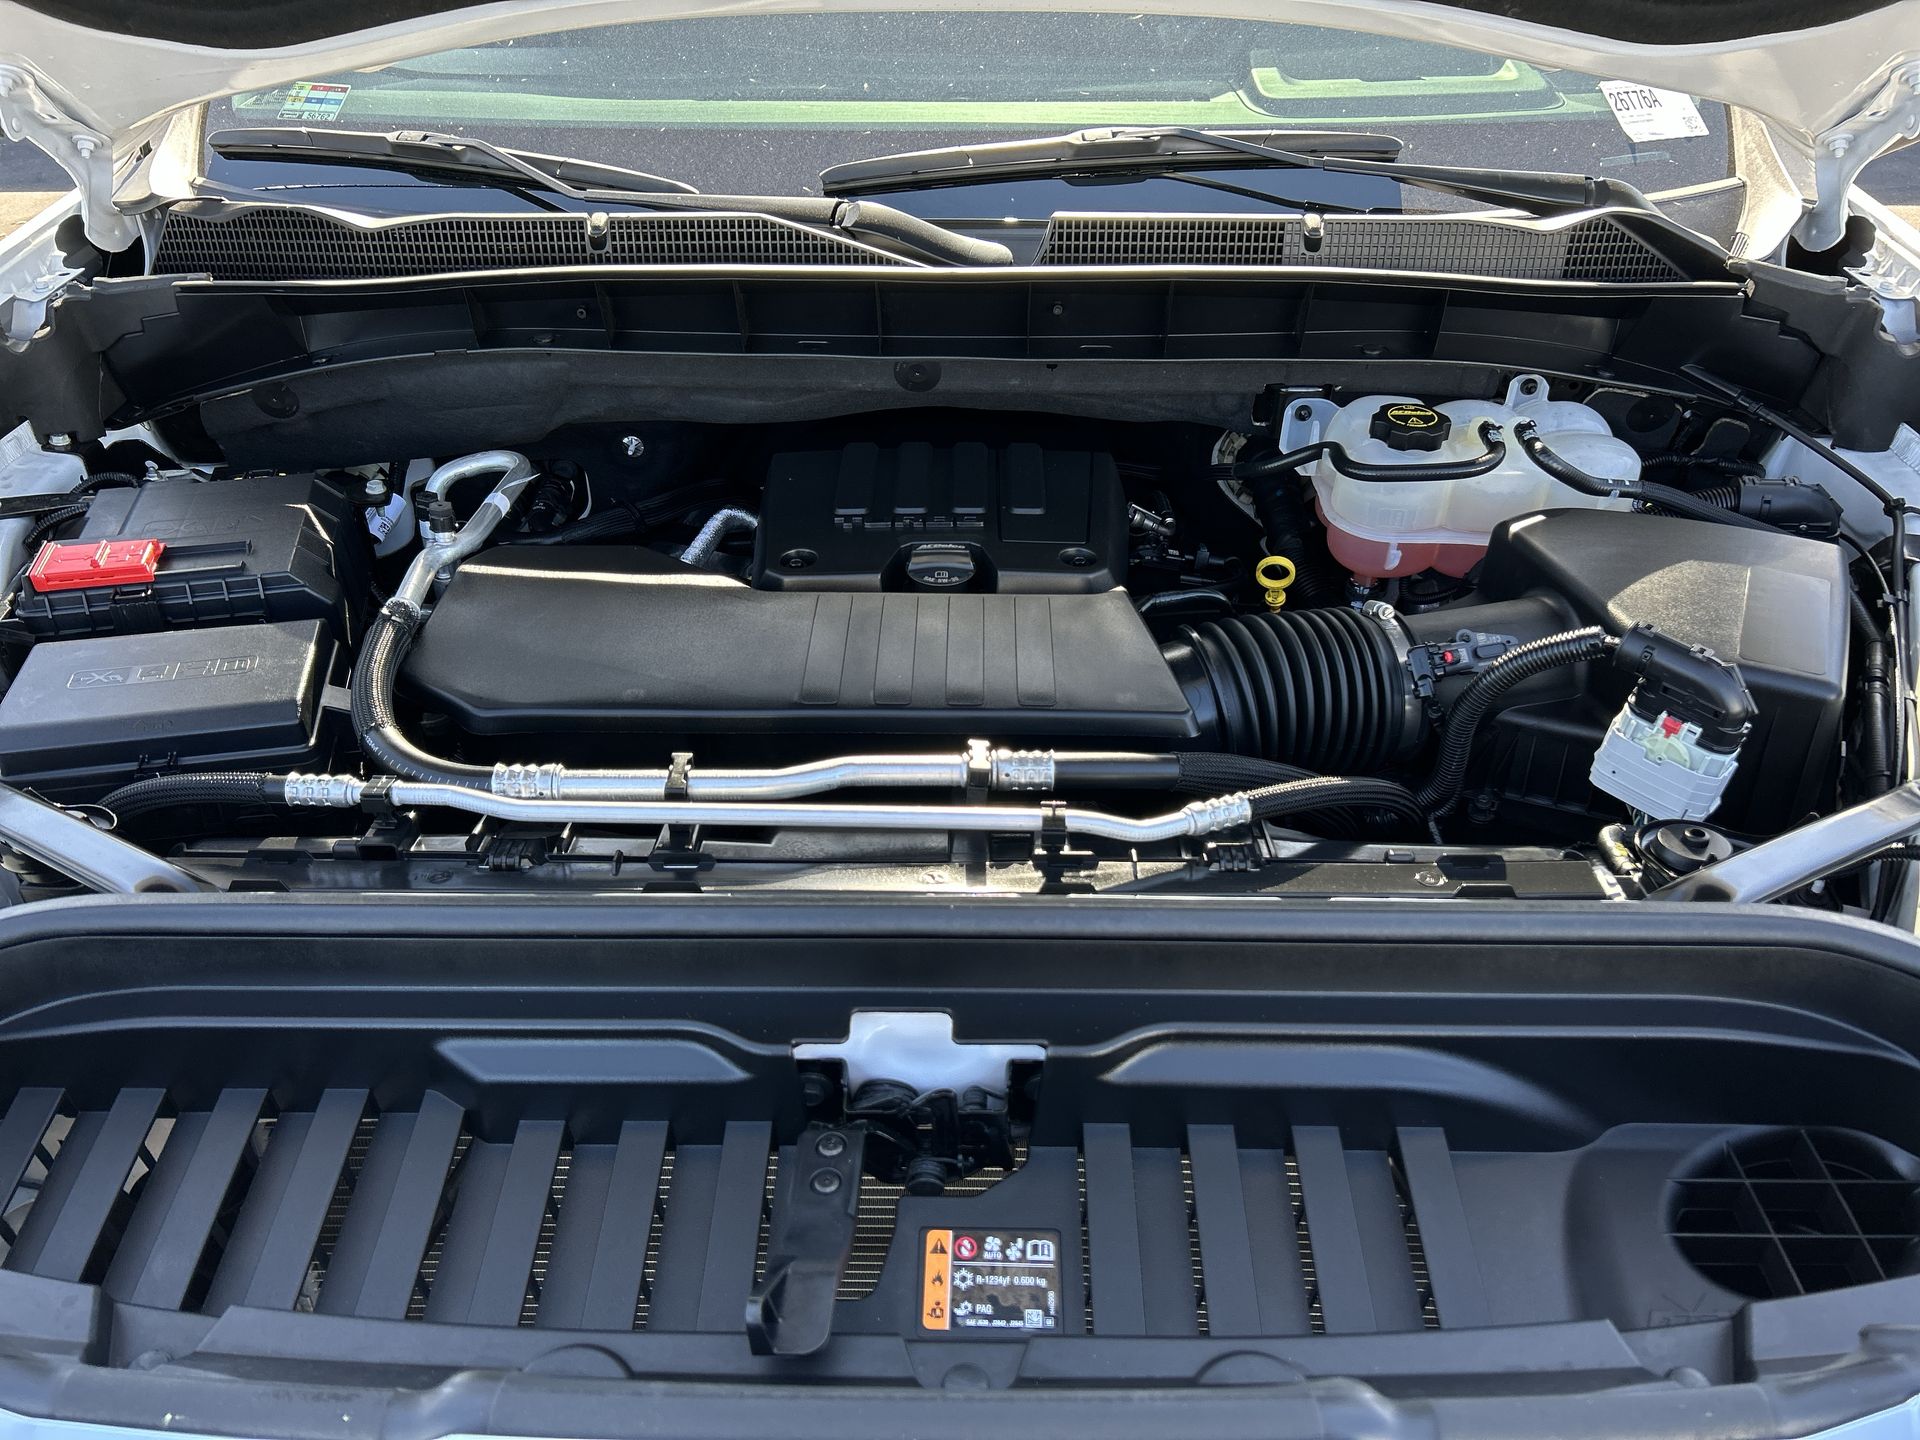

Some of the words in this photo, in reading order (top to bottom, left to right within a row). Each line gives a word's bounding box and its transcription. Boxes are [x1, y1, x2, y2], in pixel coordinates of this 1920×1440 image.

[1608, 88, 1663, 112] 26T76A
[306, 112, 331, 120] 56762
[983, 1251, 1002, 1260] AUTO
[976, 1275, 1010, 1287] R-1234yf
[1036, 1276, 1047, 1288] kg
[975, 1304, 993, 1315] PAG
